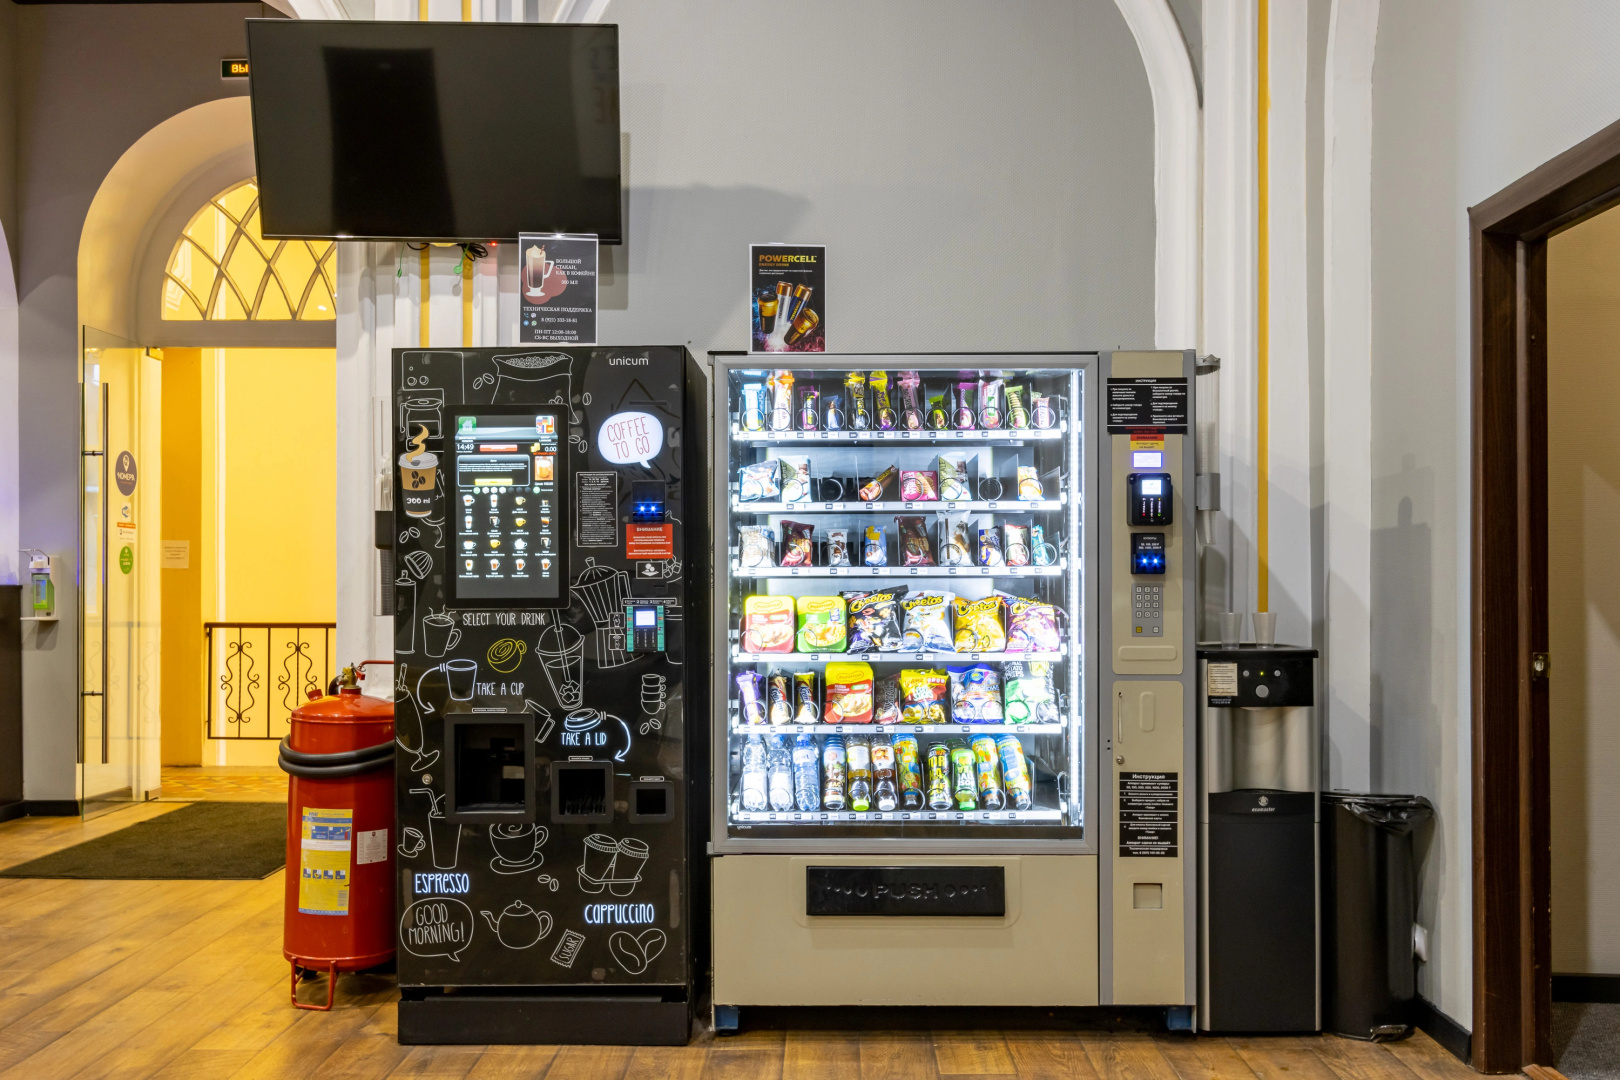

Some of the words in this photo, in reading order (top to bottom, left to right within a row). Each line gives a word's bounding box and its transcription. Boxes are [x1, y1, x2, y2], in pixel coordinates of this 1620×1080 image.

[609, 356, 649, 366] unicum
[607, 416, 649, 442] COFFEE
[613, 440, 629, 459] TO
[635, 435, 650, 455] GO
[850, 593, 893, 613] Cheetos
[902, 595, 943, 611] Cheetos
[462, 613, 490, 626] SELECT
[495, 613, 516, 626] YOUR
[521, 612, 545, 626] DRINK
[476, 682, 496, 695] TAKE
[501, 682, 506, 695] A
[511, 682, 524, 695] CUP
[561, 732, 581, 745] TAKE
[585, 732, 591, 745] A
[595, 732, 607, 745] LID
[874, 883, 938, 899] PUSH
[416, 903, 448, 926] GOOD
[409, 921, 465, 945] MORNING!
[559, 936, 579, 960] SUGAR
